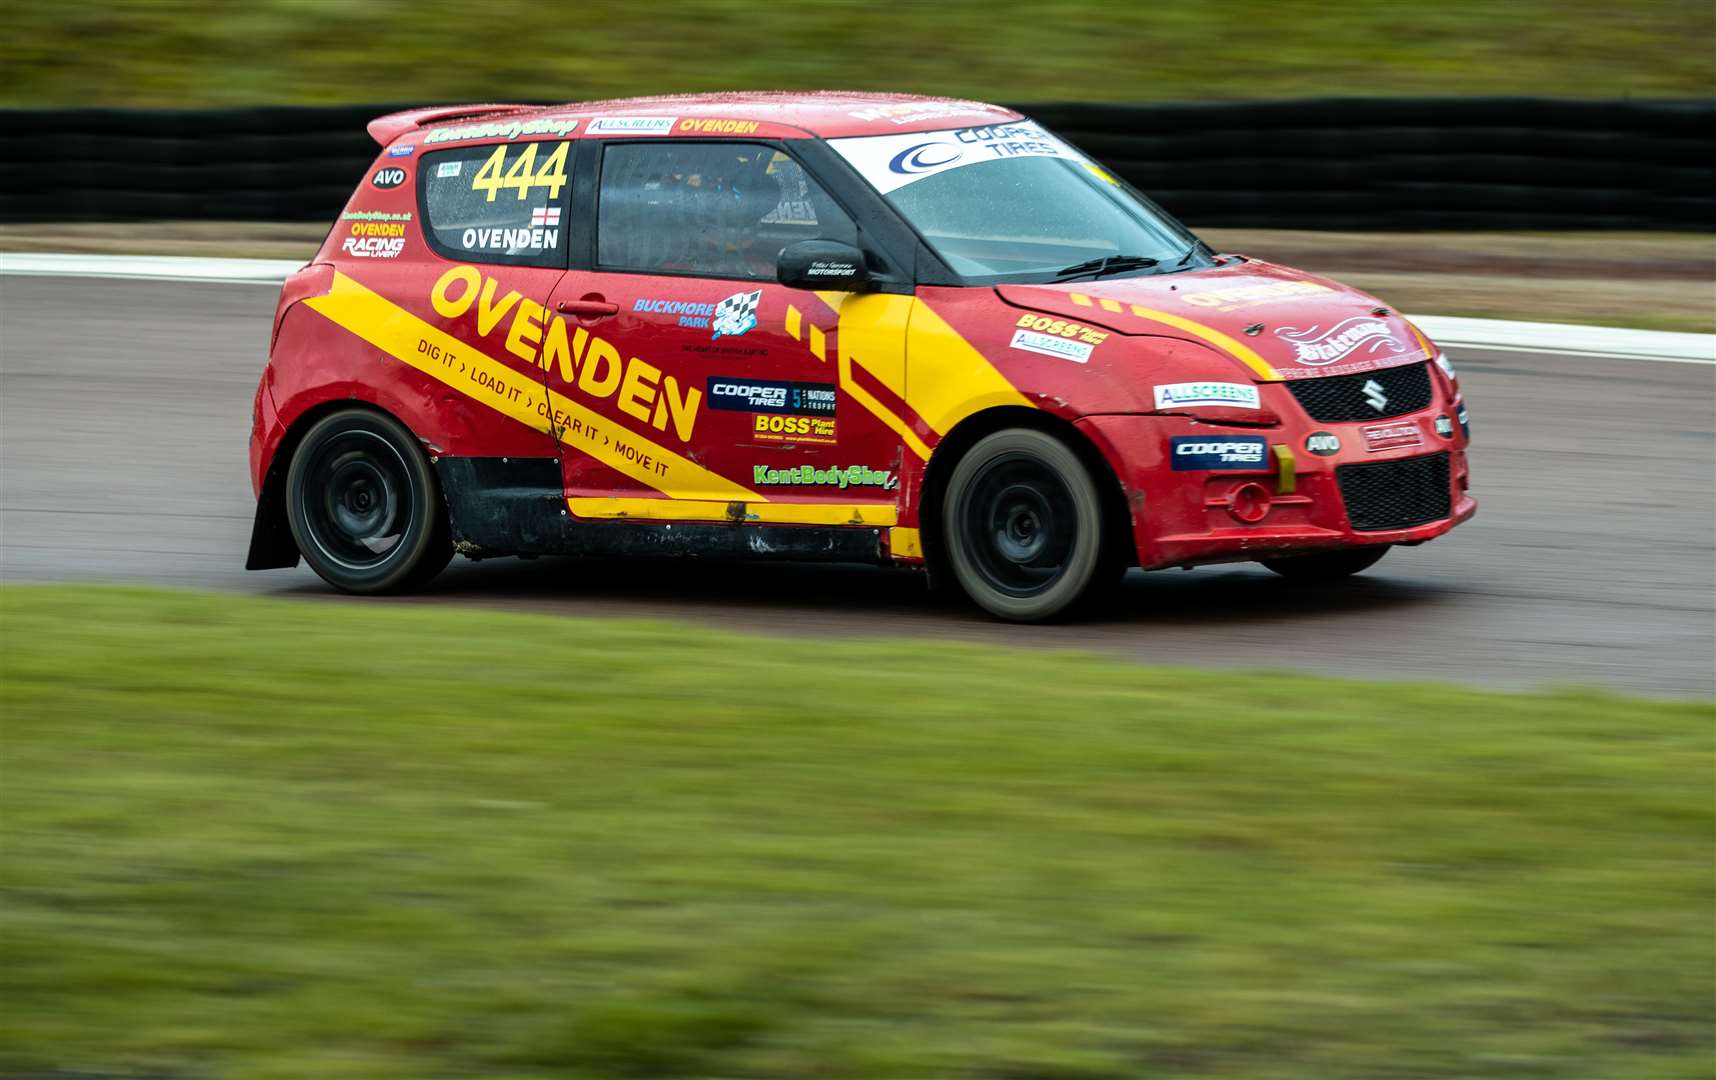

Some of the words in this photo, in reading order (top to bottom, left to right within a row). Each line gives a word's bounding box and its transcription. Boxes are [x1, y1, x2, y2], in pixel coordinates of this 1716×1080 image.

[591, 118, 672, 131] ALLSCREENS
[679, 119, 760, 134] OVENDEN
[985, 141, 1059, 158] TIRES
[373, 170, 405, 185] AVO
[472, 141, 570, 202] 444
[351, 223, 406, 237] OVENDEN
[342, 238, 406, 256] RACING
[463, 229, 558, 249] OVENDEN
[808, 268, 857, 276] MOTORSPORT
[633, 299, 716, 317] BUCKMORE
[678, 316, 710, 328] PARK
[1016, 313, 1081, 338] BOSS
[431, 265, 703, 443] OVENDEN
[712, 384, 787, 400] COOPER
[793, 389, 801, 408] 5
[807, 390, 836, 402] NATIONS
[1162, 385, 1255, 404] ALLSCREENS
[417, 339, 440, 361] DIG
[443, 352, 456, 368] IT
[470, 367, 505, 395] LOAD
[508, 387, 522, 403] IT
[537, 403, 582, 433] CLEAR
[585, 425, 599, 440] IT
[615, 440, 652, 470] MOVE
[655, 461, 670, 477] IT
[748, 397, 786, 408] TIRES
[756, 415, 810, 434] BOSS
[811, 419, 835, 428] Plant
[815, 427, 834, 436] Hire
[1176, 443, 1264, 455] COOPER
[1307, 435, 1340, 451] AVO
[1219, 453, 1263, 462] TIRES
